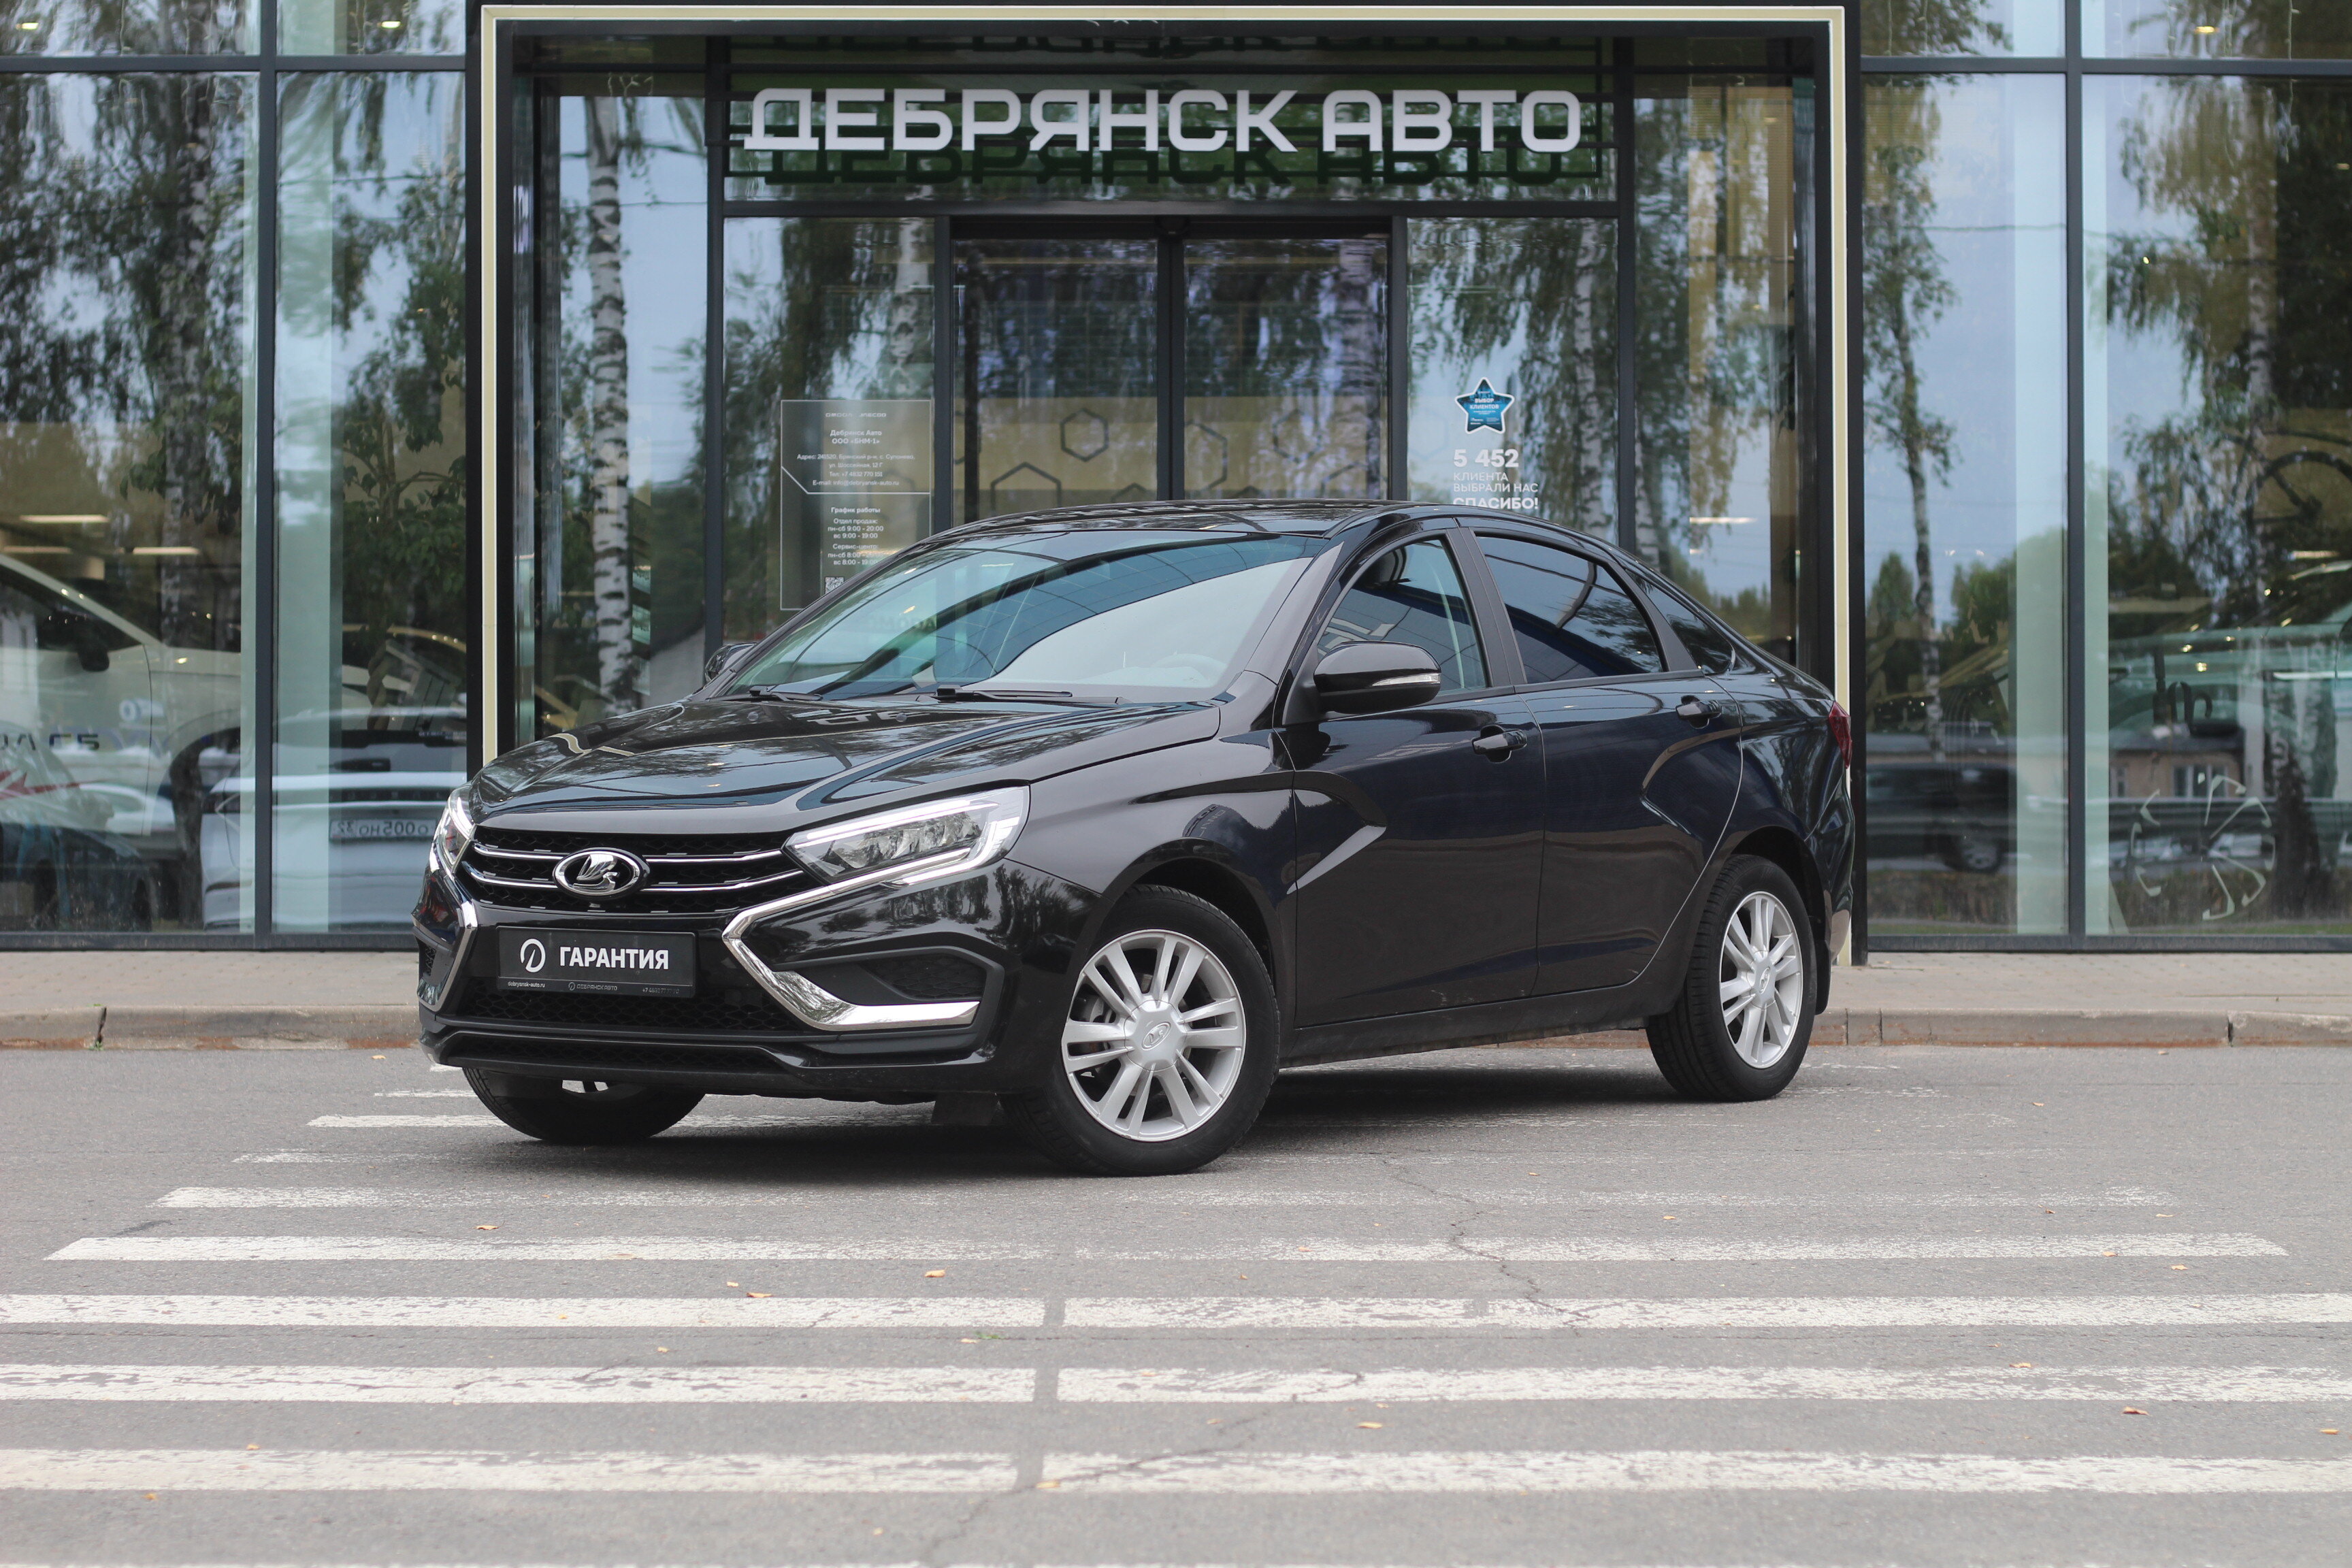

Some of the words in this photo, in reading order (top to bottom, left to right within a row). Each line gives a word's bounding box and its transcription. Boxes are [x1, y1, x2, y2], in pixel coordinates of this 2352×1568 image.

[743, 88, 1298, 153] ДЕБРЯНСК
[1322, 89, 1581, 154] АВТО
[1454, 449, 1467, 468] 5
[1475, 449, 1519, 468] 452
[1454, 472, 1509, 482] КЛИЕНТА
[1454, 483, 1511, 493] ВЫБРАЛИ
[1514, 483, 1538, 493] НАС
[1453, 497, 1539, 510] СПАСИБО!
[559, 947, 669, 970] ГАРАНТИЯ
